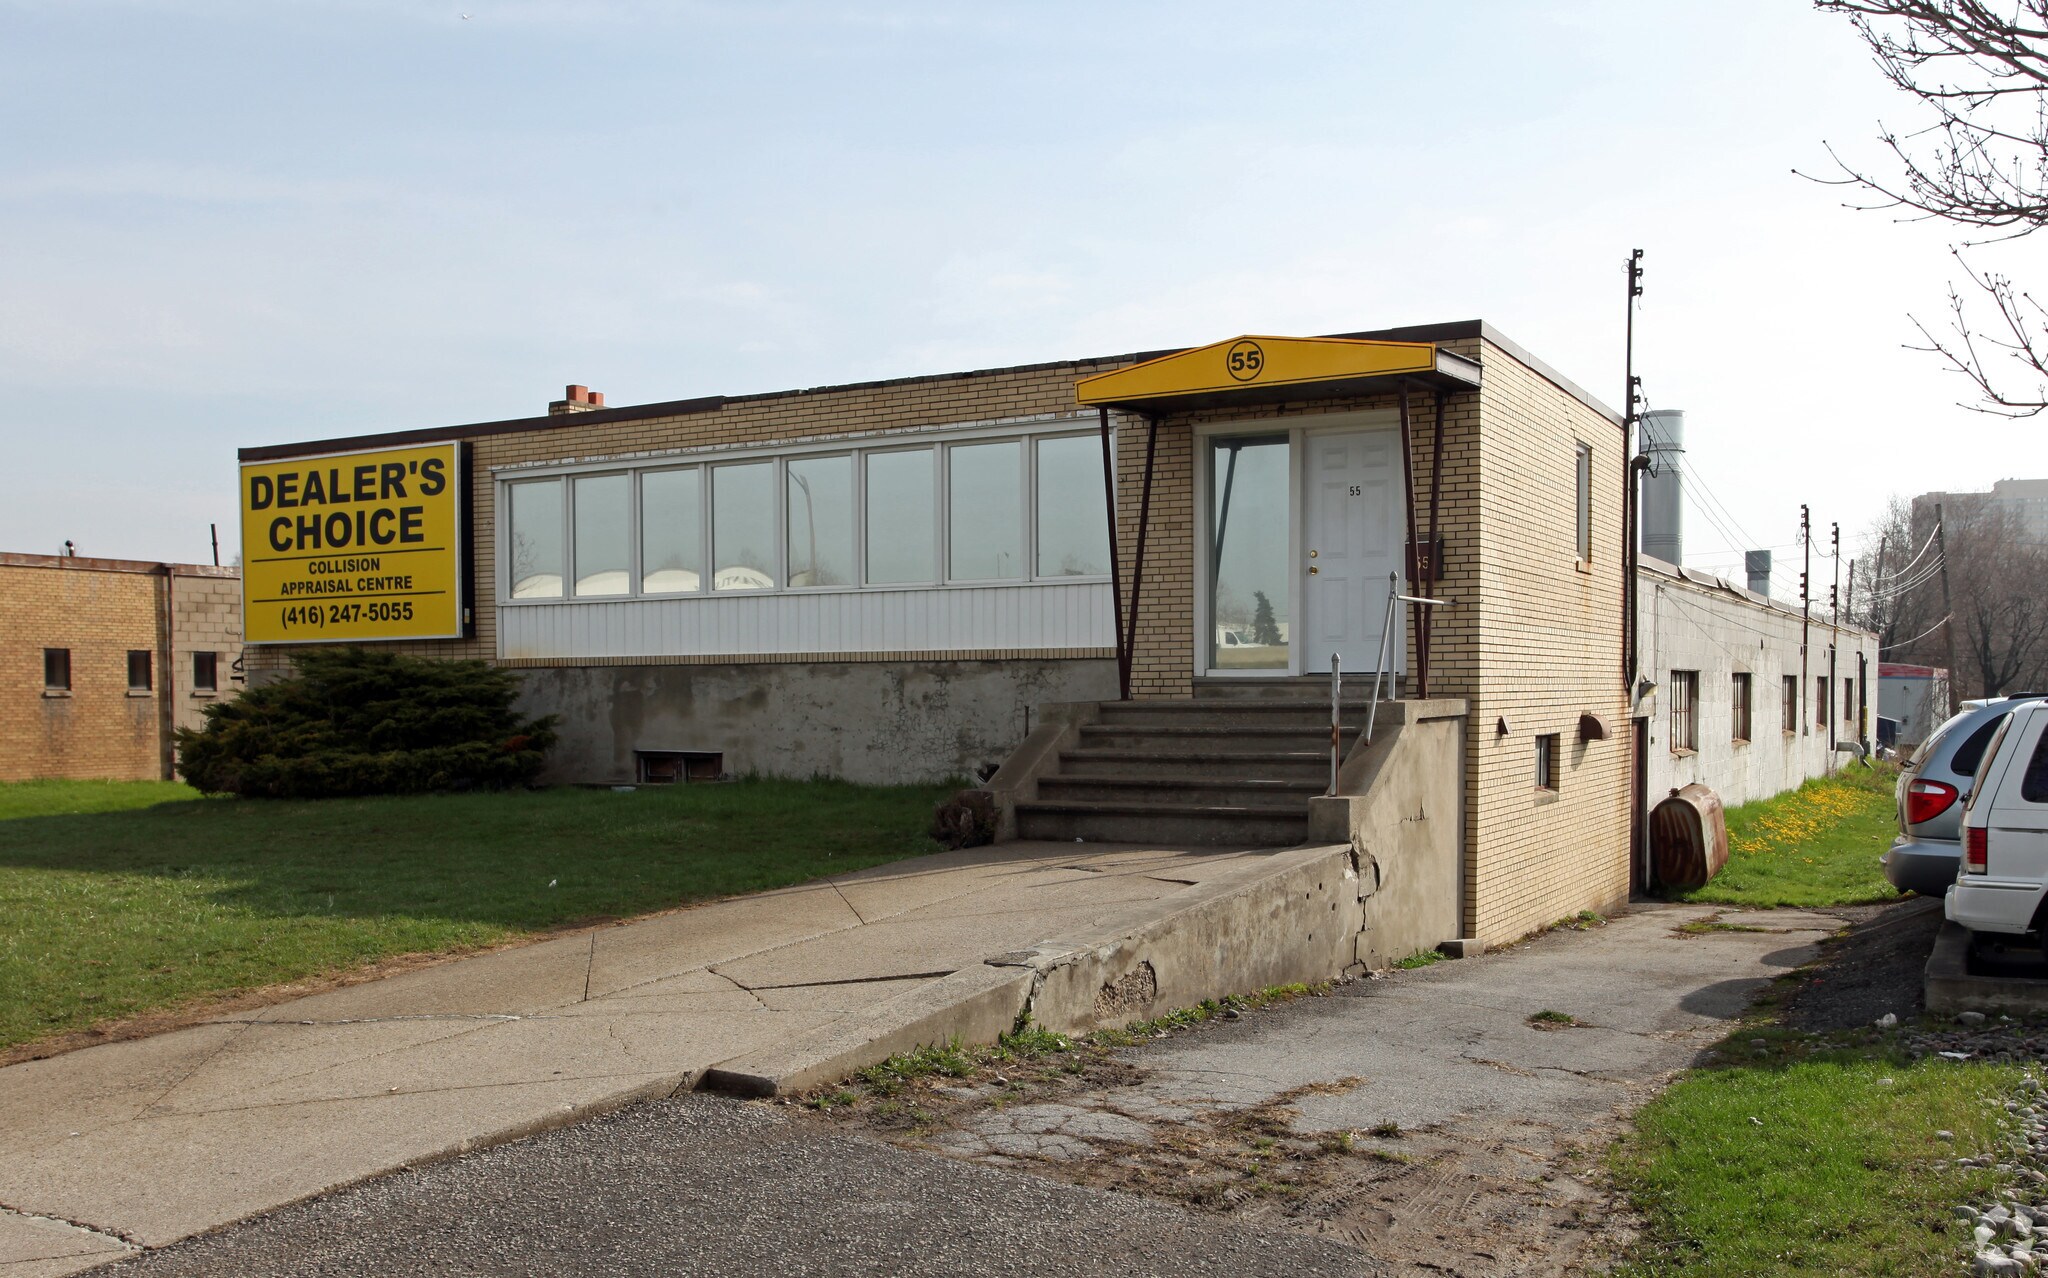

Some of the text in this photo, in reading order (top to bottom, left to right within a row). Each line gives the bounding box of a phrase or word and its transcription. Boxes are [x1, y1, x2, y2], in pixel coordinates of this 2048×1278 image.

[1231, 350, 1260, 371] 55
[251, 458, 446, 510] DEALER'S
[1350, 486, 1361, 496] 55
[269, 506, 424, 552] CHOICE
[308, 558, 380, 574] COLLISION
[280, 576, 413, 595] APPRAISAL CENTRE
[282, 602, 413, 630] (416) 247-5055
